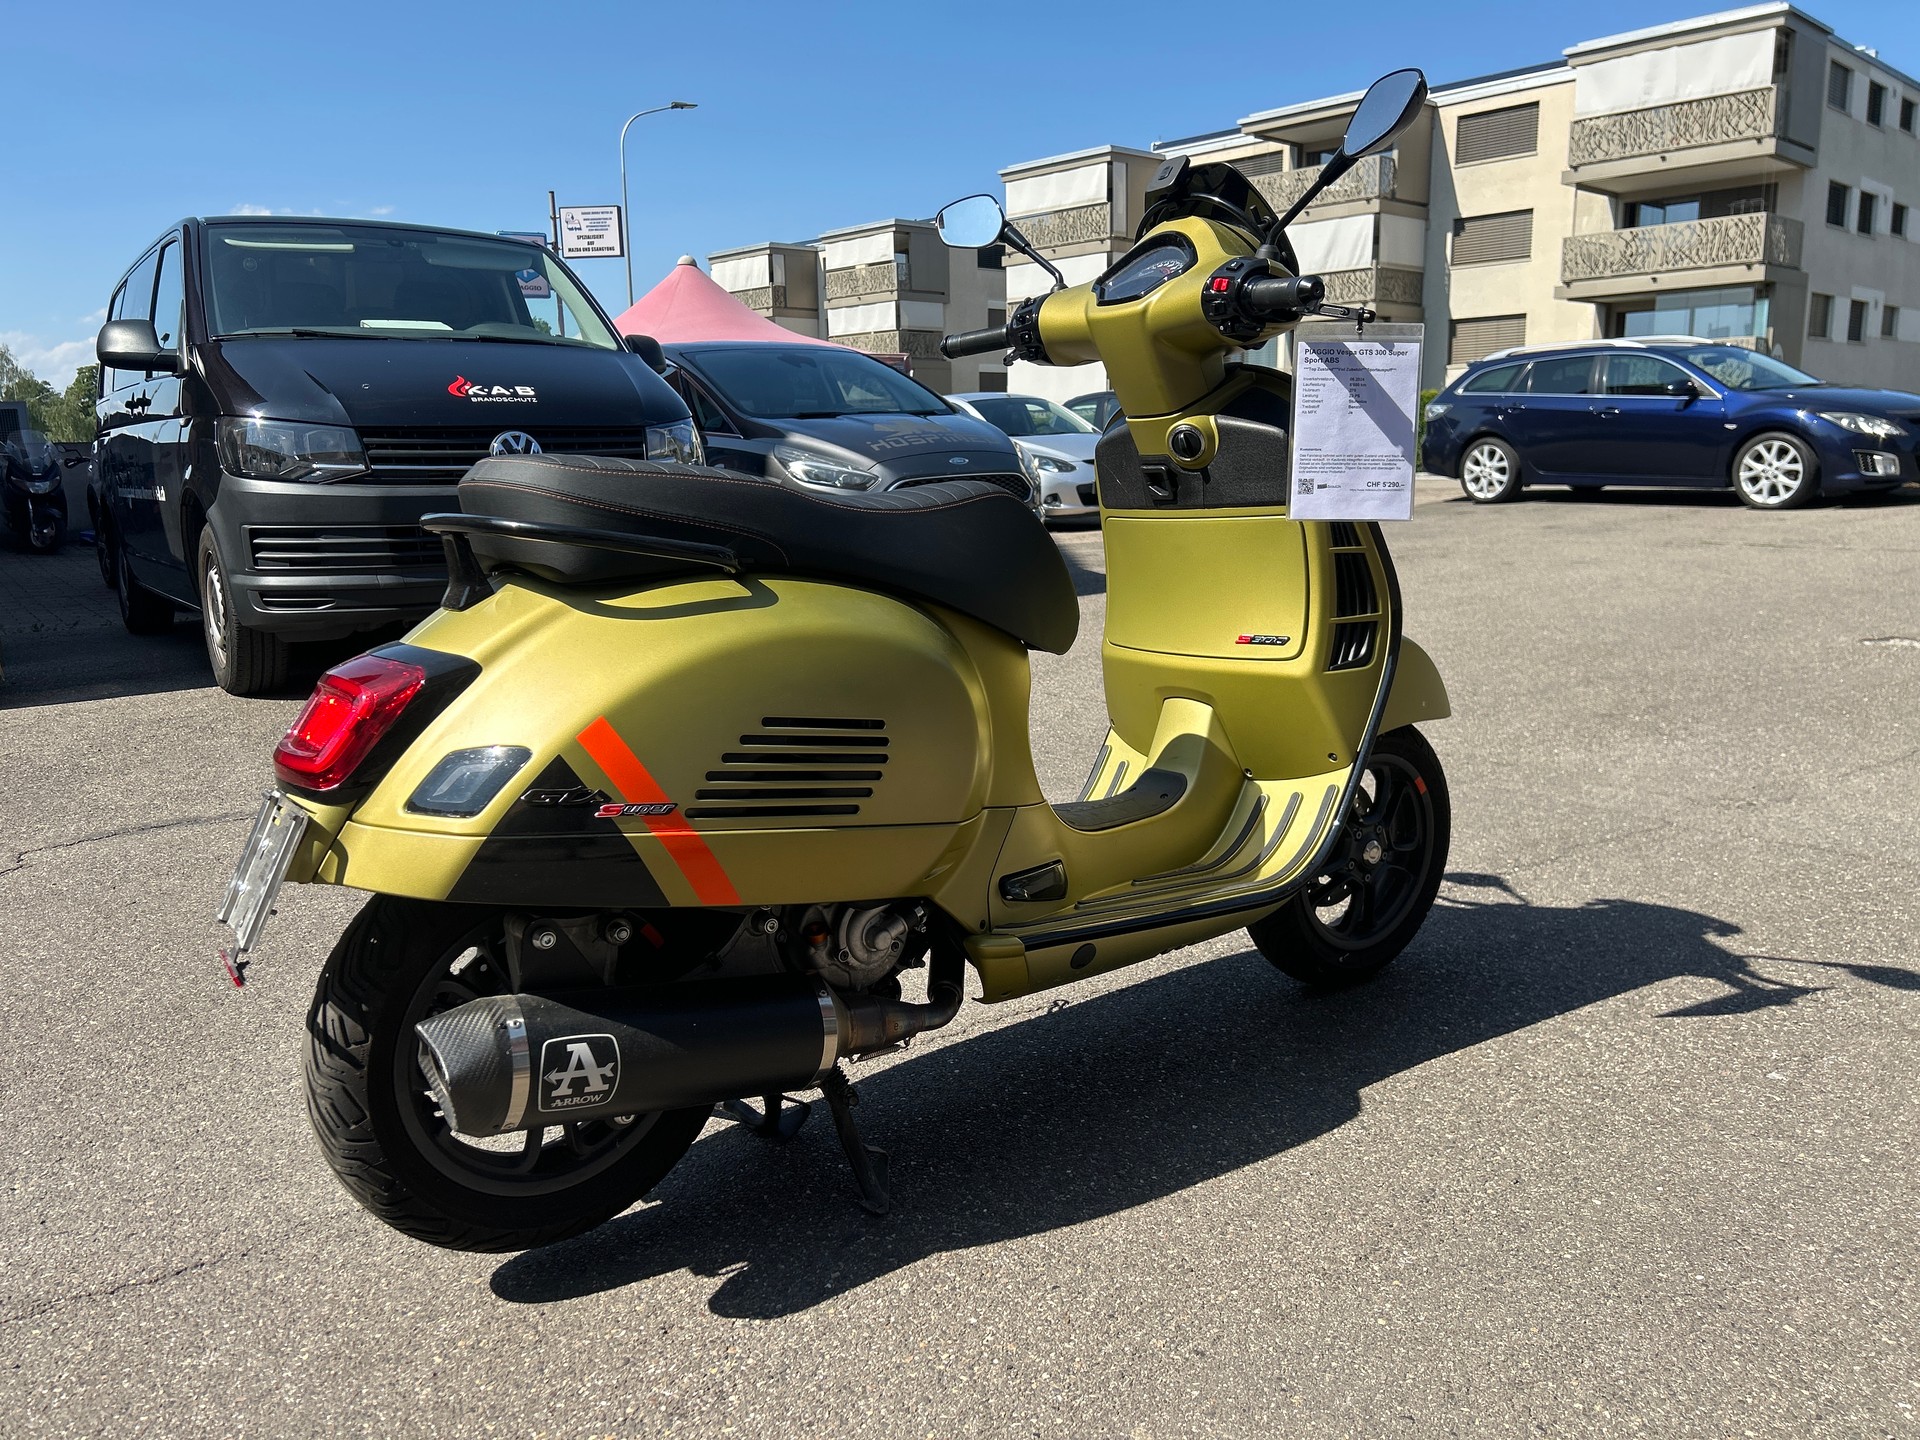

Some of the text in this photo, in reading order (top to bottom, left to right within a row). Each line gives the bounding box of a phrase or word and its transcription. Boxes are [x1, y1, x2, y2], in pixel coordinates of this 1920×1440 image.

[1304, 348, 1335, 356] PIAGGIO
[1336, 348, 1358, 357] Vespa
[1388, 349, 1408, 357] Super
[1304, 357, 1323, 365] Sport
[594, 803, 678, 818] Super
[550, 1093, 604, 1108] ARROW
